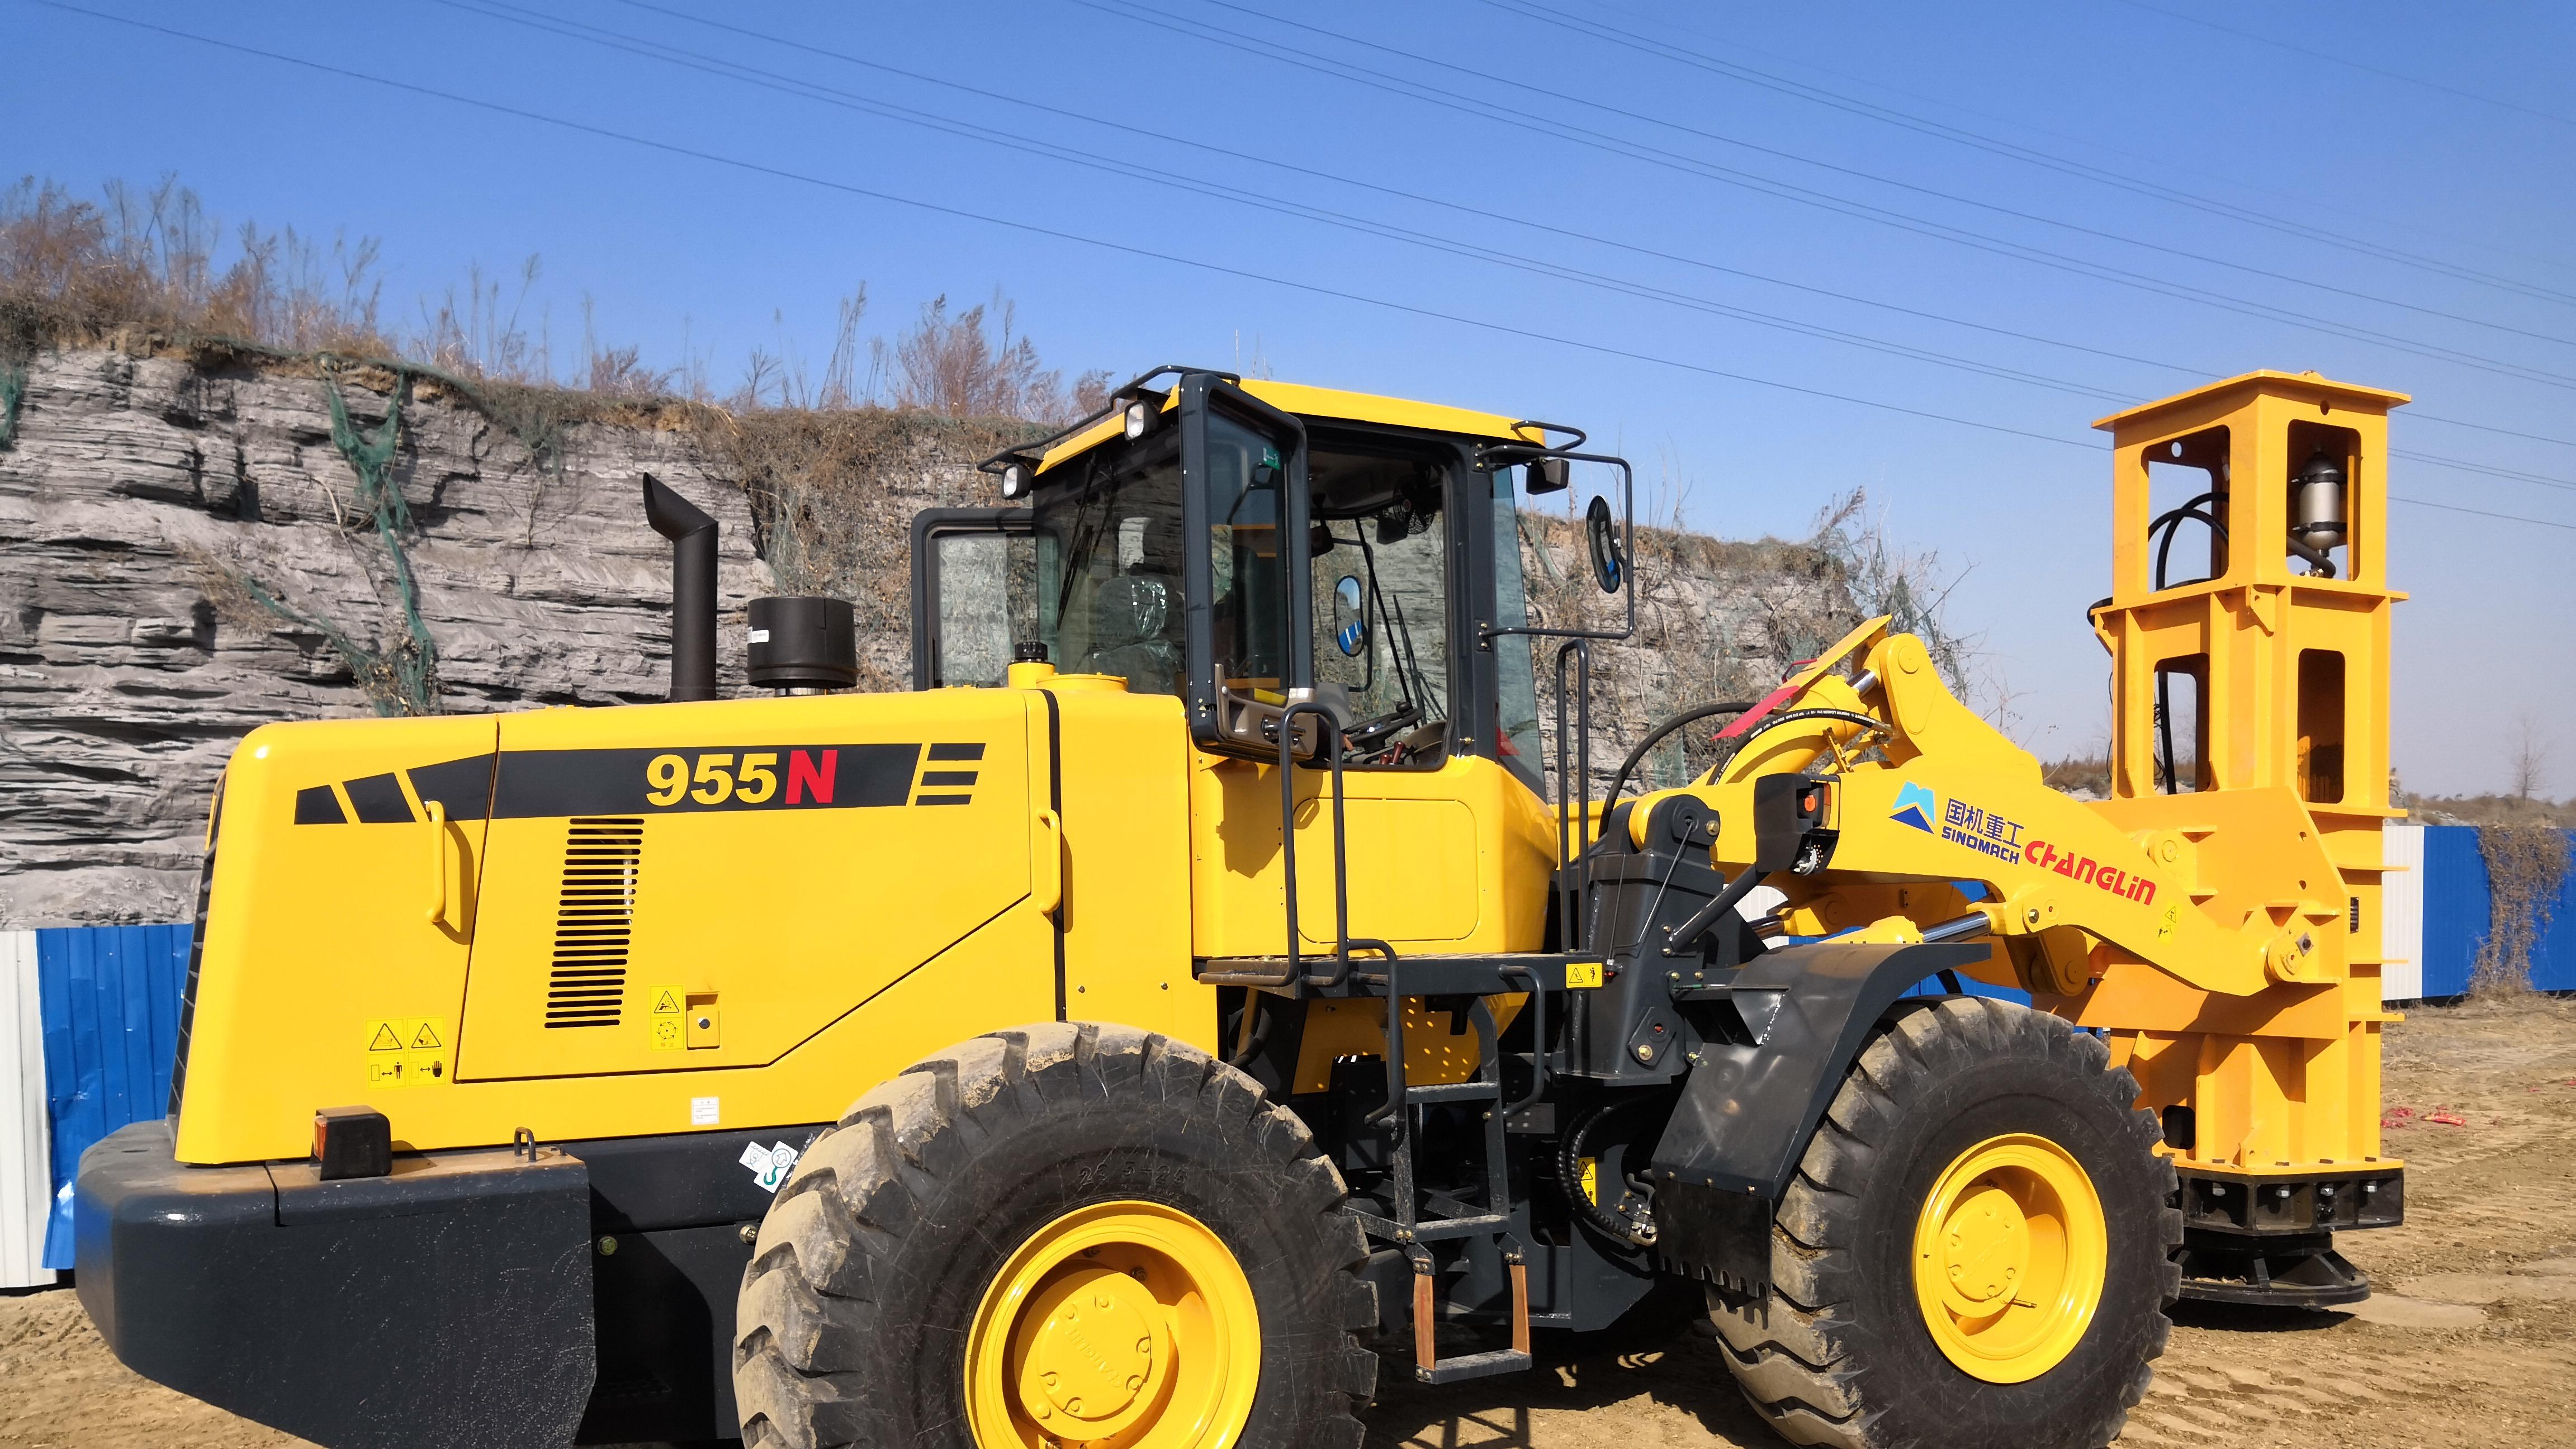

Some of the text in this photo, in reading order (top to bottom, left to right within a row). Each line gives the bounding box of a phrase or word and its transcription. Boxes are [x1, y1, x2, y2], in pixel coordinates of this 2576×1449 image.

[646, 750, 837, 806] 955N
[1942, 826, 2019, 865] SINOMACH
[1945, 798, 2024, 849] 国机重工
[1078, 1161, 1186, 1185] 235-25
